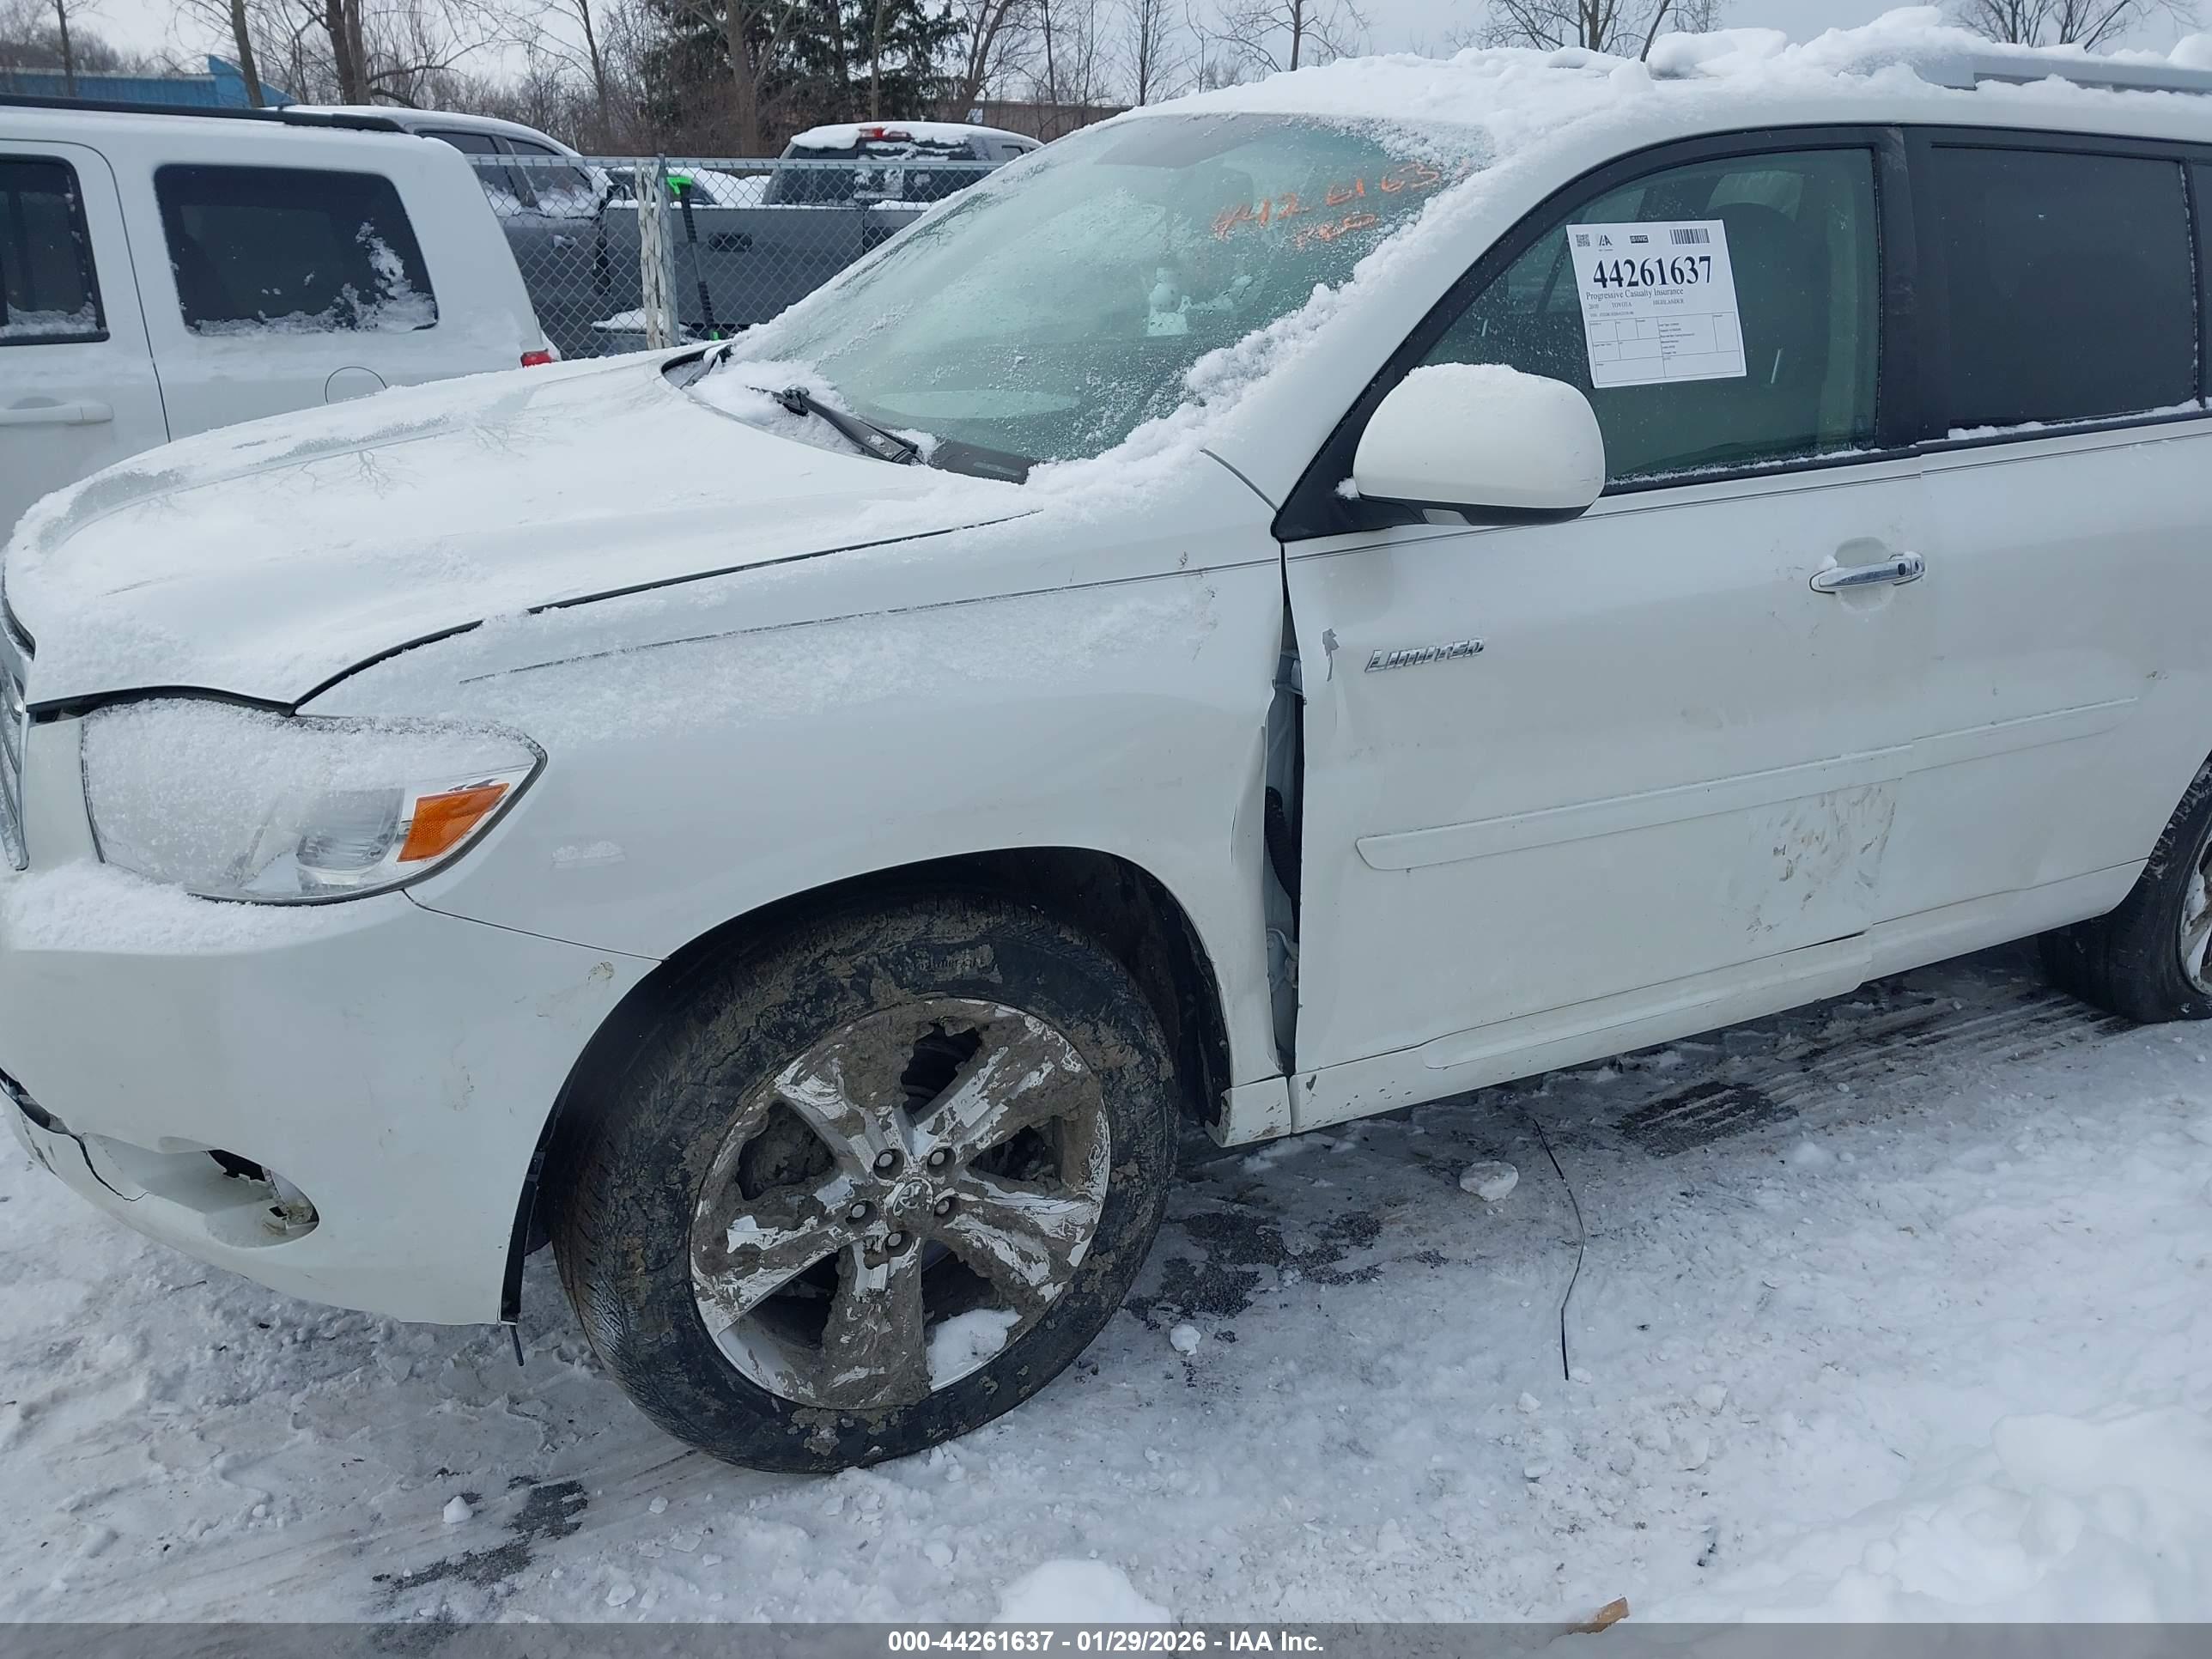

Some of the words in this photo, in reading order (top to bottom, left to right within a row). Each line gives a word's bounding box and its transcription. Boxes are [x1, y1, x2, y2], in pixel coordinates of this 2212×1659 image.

[1593, 255, 1711, 289] 44261637
[1586, 291, 1624, 301] Progressive
[1625, 289, 1652, 300] Casualty
[1654, 288, 1684, 296] Insurance
